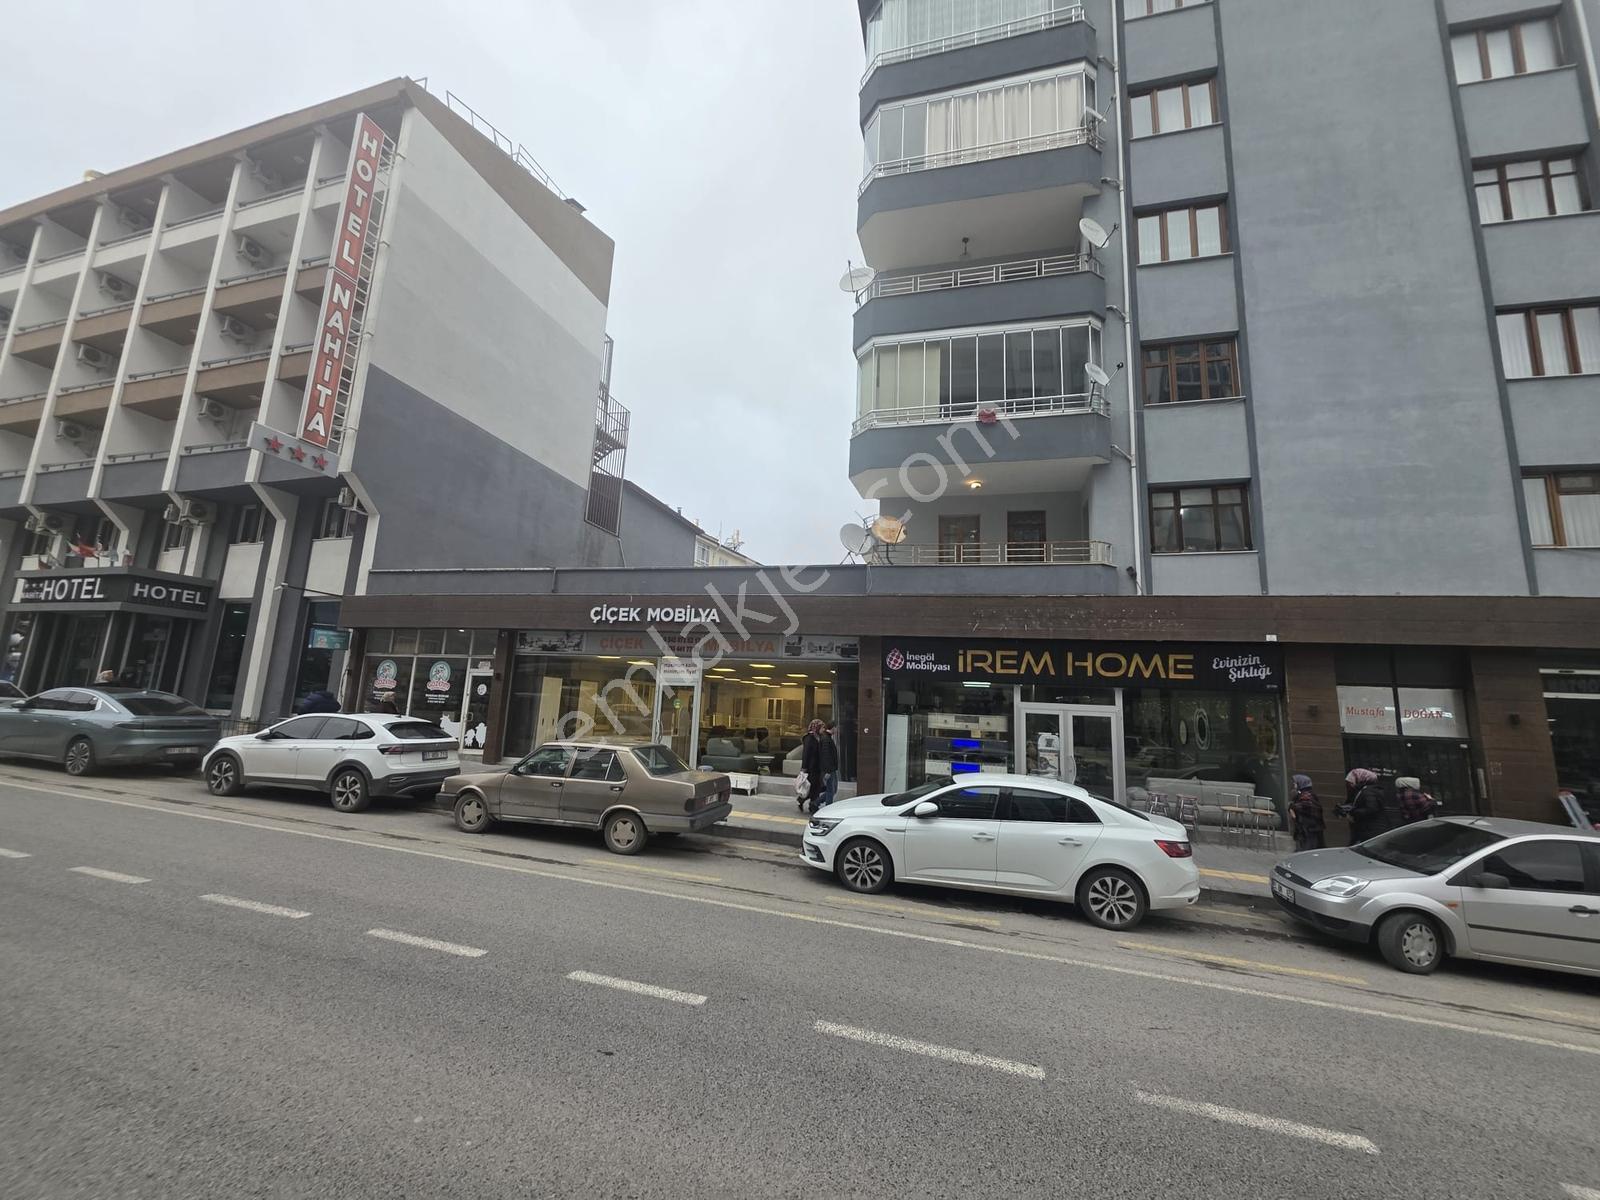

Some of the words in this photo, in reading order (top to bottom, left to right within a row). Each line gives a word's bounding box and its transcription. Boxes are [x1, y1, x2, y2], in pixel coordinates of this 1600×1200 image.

[342, 129, 380, 266] HOTEL
[41, 578, 105, 600] HOTEL
[133, 582, 207, 605] HOTEL
[589, 603, 642, 624] ÇİÇEK
[647, 604, 720, 622] MOBİLYA
[600, 635, 644, 651] ÇİÇEK
[906, 650, 935, 662] İnegöl
[1066, 651, 1195, 680] HOME
[1212, 654, 1261, 669] Evinizin
[906, 662, 951, 673] Mobilyası
[1228, 664, 1273, 683] Şıklığı
[1345, 705, 1385, 719] Mustafa
